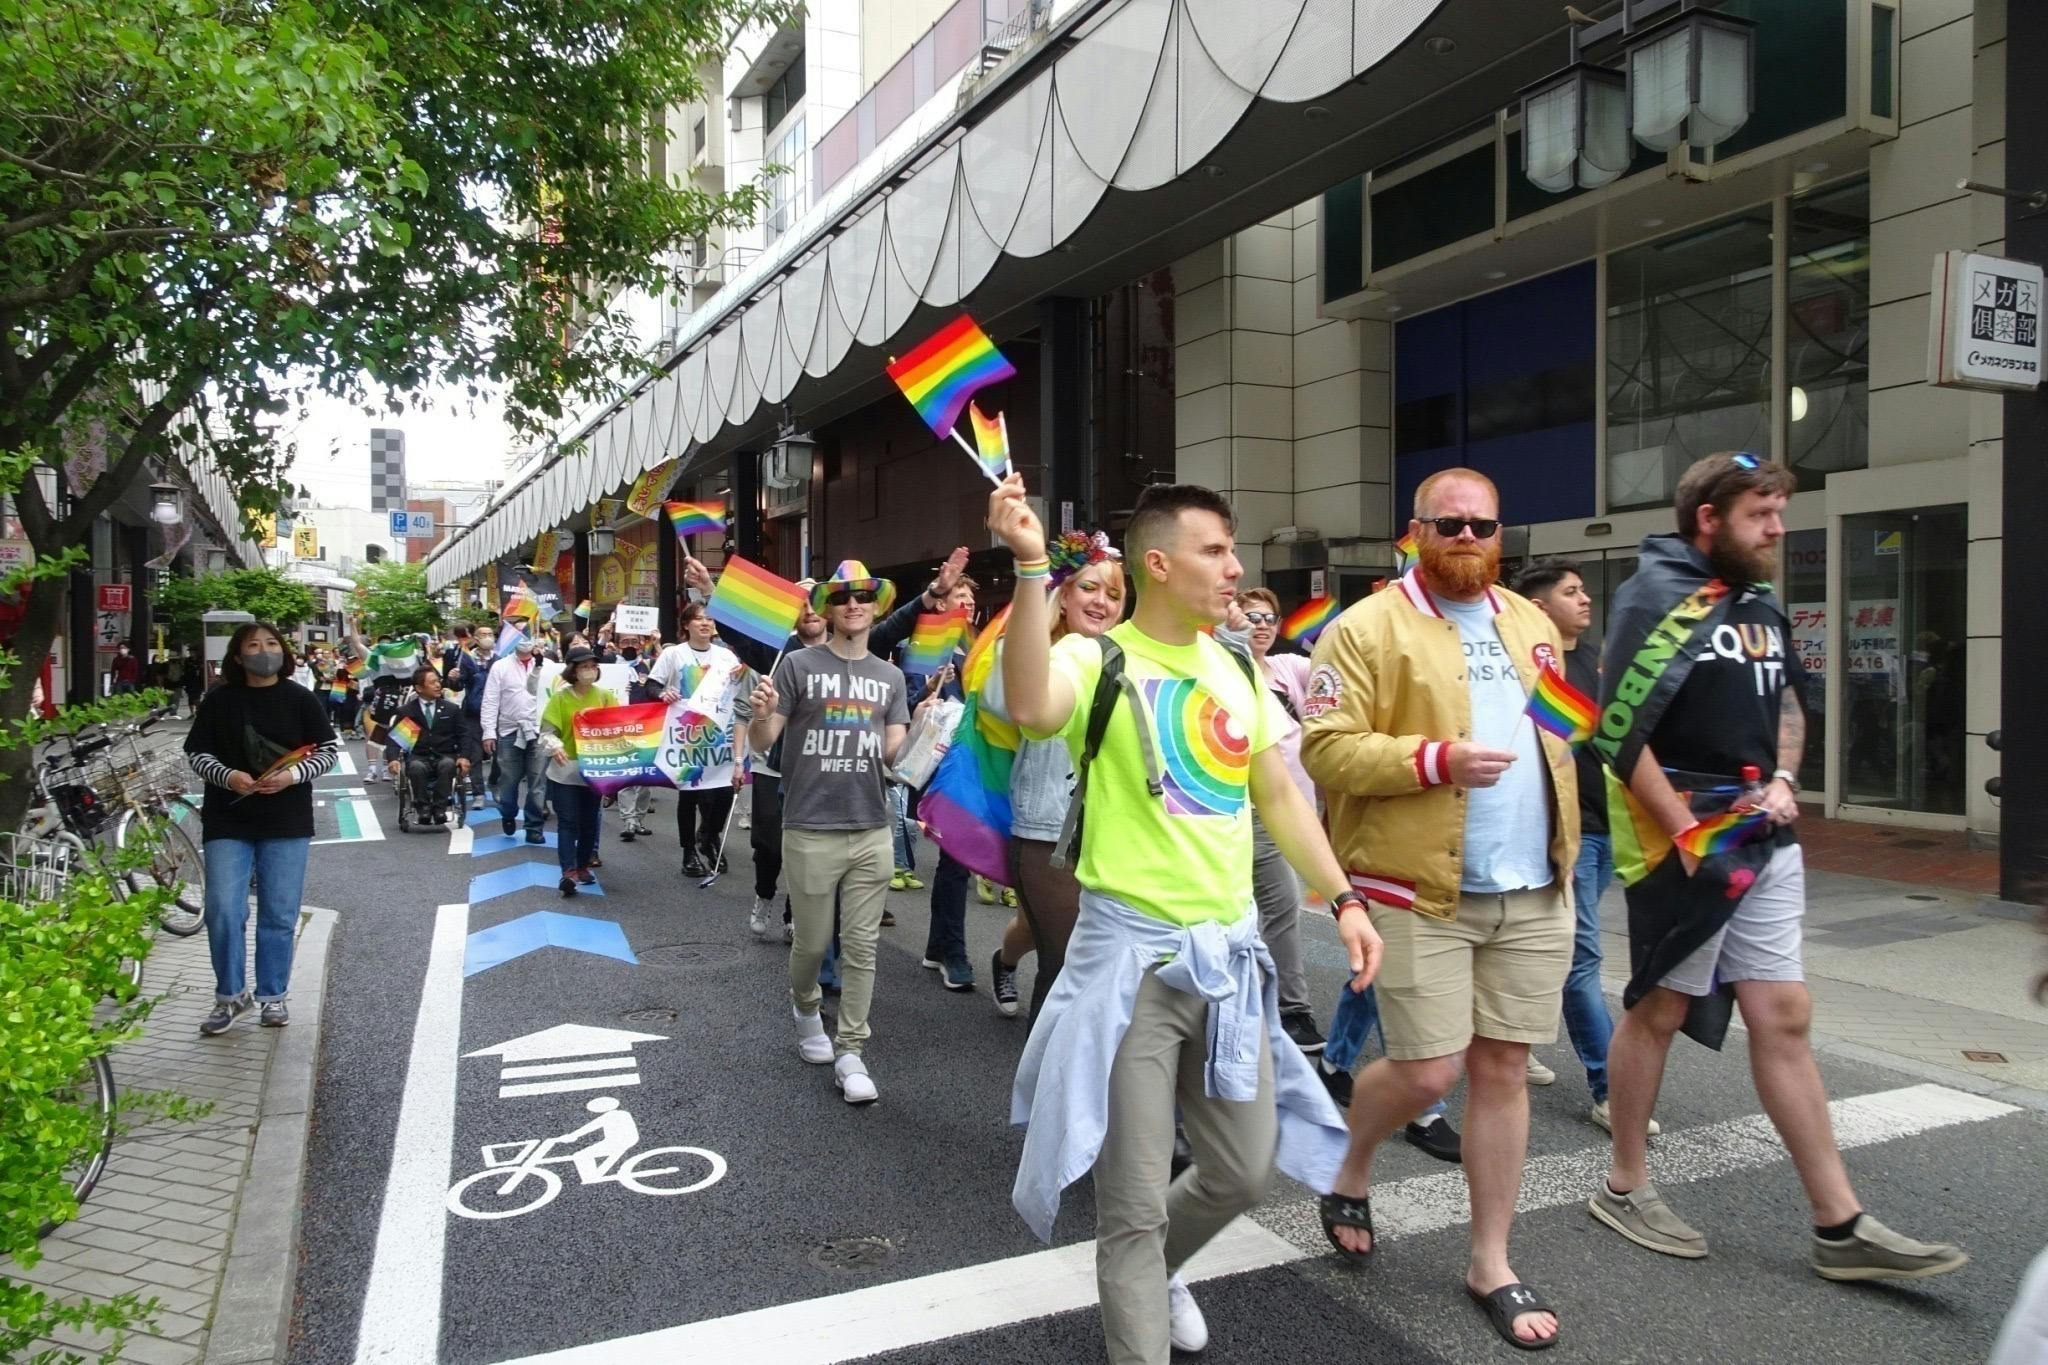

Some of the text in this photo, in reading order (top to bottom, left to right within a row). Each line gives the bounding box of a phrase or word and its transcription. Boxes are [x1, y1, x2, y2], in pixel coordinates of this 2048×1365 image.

[1973, 279, 2037, 312] メガネ
[1501, 664, 1520, 681] K
[1753, 660, 1787, 697] IT
[806, 673, 891, 707] I'M NOT
[824, 699, 874, 727] GAY
[802, 729, 882, 759] BUT MY
[820, 758, 869, 773] WIFE IS
